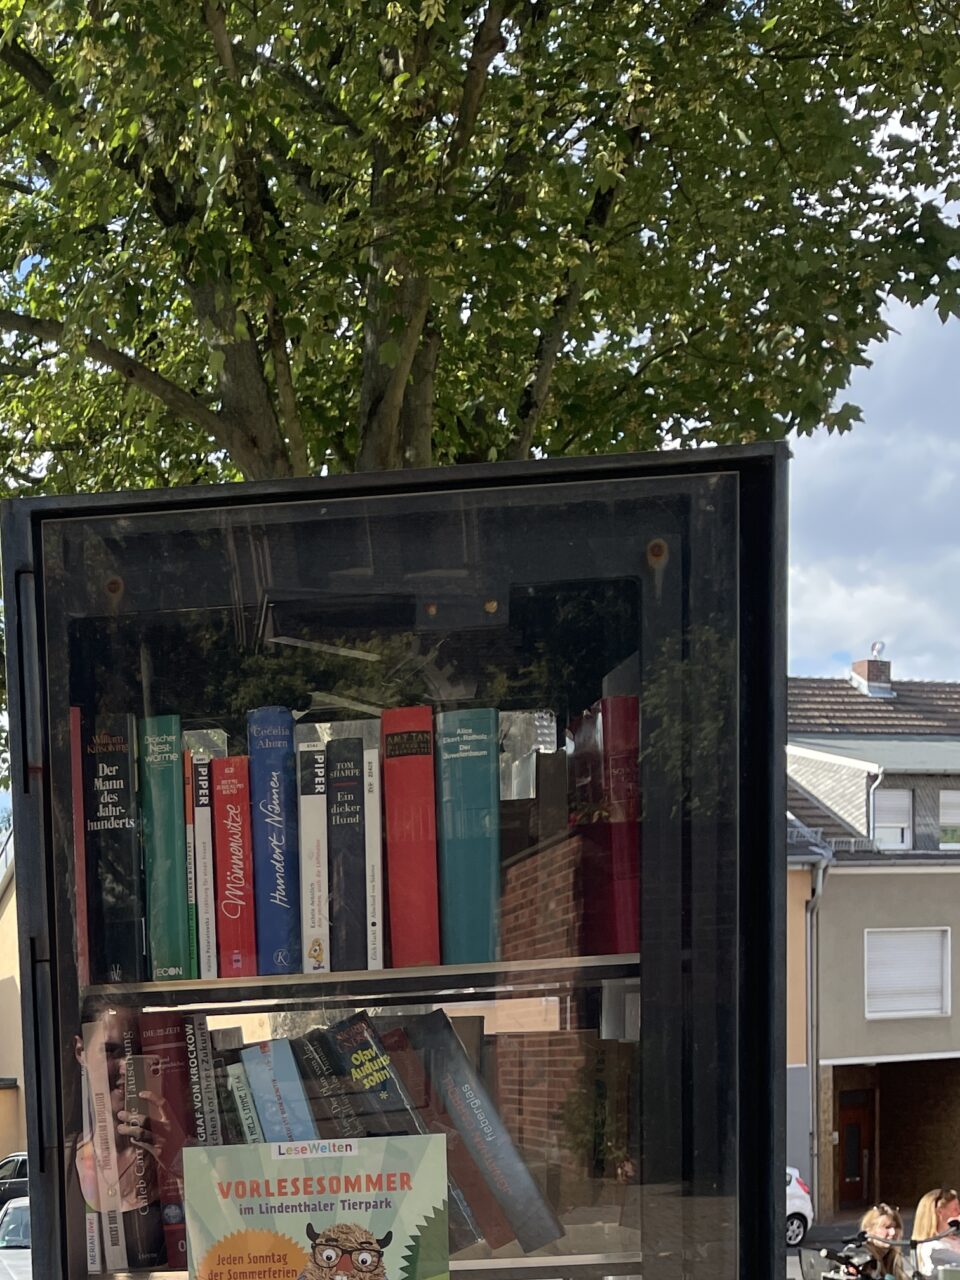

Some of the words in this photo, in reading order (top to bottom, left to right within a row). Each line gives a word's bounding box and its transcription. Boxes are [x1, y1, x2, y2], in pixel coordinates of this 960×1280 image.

[253, 726, 290, 737] Cecelia
[149, 743, 172, 753] Nest-
[257, 739, 288, 749] Ahern
[98, 763, 119, 776] Der
[314, 755, 325, 793] PIPER
[330, 768, 360, 777] SHARPE
[94, 778, 124, 790] Mann
[198, 767, 209, 805] PIPER
[100, 791, 119, 803] des
[259, 771, 284, 827] Namen
[337, 792, 354, 801] Ein
[97, 804, 126, 817] Jahr-
[331, 804, 360, 813] dicker
[87, 818, 135, 831] hunderts
[332, 814, 359, 825] Hund
[221, 804, 246, 919] Männerwitze
[270, 836, 290, 908] Hundert
[156, 967, 183, 976] ECON
[200, 1021, 208, 1065] Zukunft
[187, 1023, 199, 1082] KROCKOW
[351, 1047, 377, 1066] Olav
[125, 1030, 137, 1099] Täuschung
[351, 1055, 390, 1082] Auduns-
[363, 1070, 390, 1089] sohn
[460, 1082, 497, 1142] fieberglas
[278, 1142, 352, 1156] LeseWelten
[217, 1172, 413, 1199] VORLESESOMMER
[138, 1180, 149, 1215] Caleb
[239, 1204, 254, 1215] im
[259, 1200, 335, 1214] Lindenthaler
[340, 1197, 392, 1213] Tierpark
[88, 1234, 96, 1264] MERIAN
[216, 1253, 244, 1266] Jeden
[247, 1251, 288, 1266] Sonntag
[208, 1270, 225, 1280] der
[227, 1267, 298, 1280] Sommerferien
